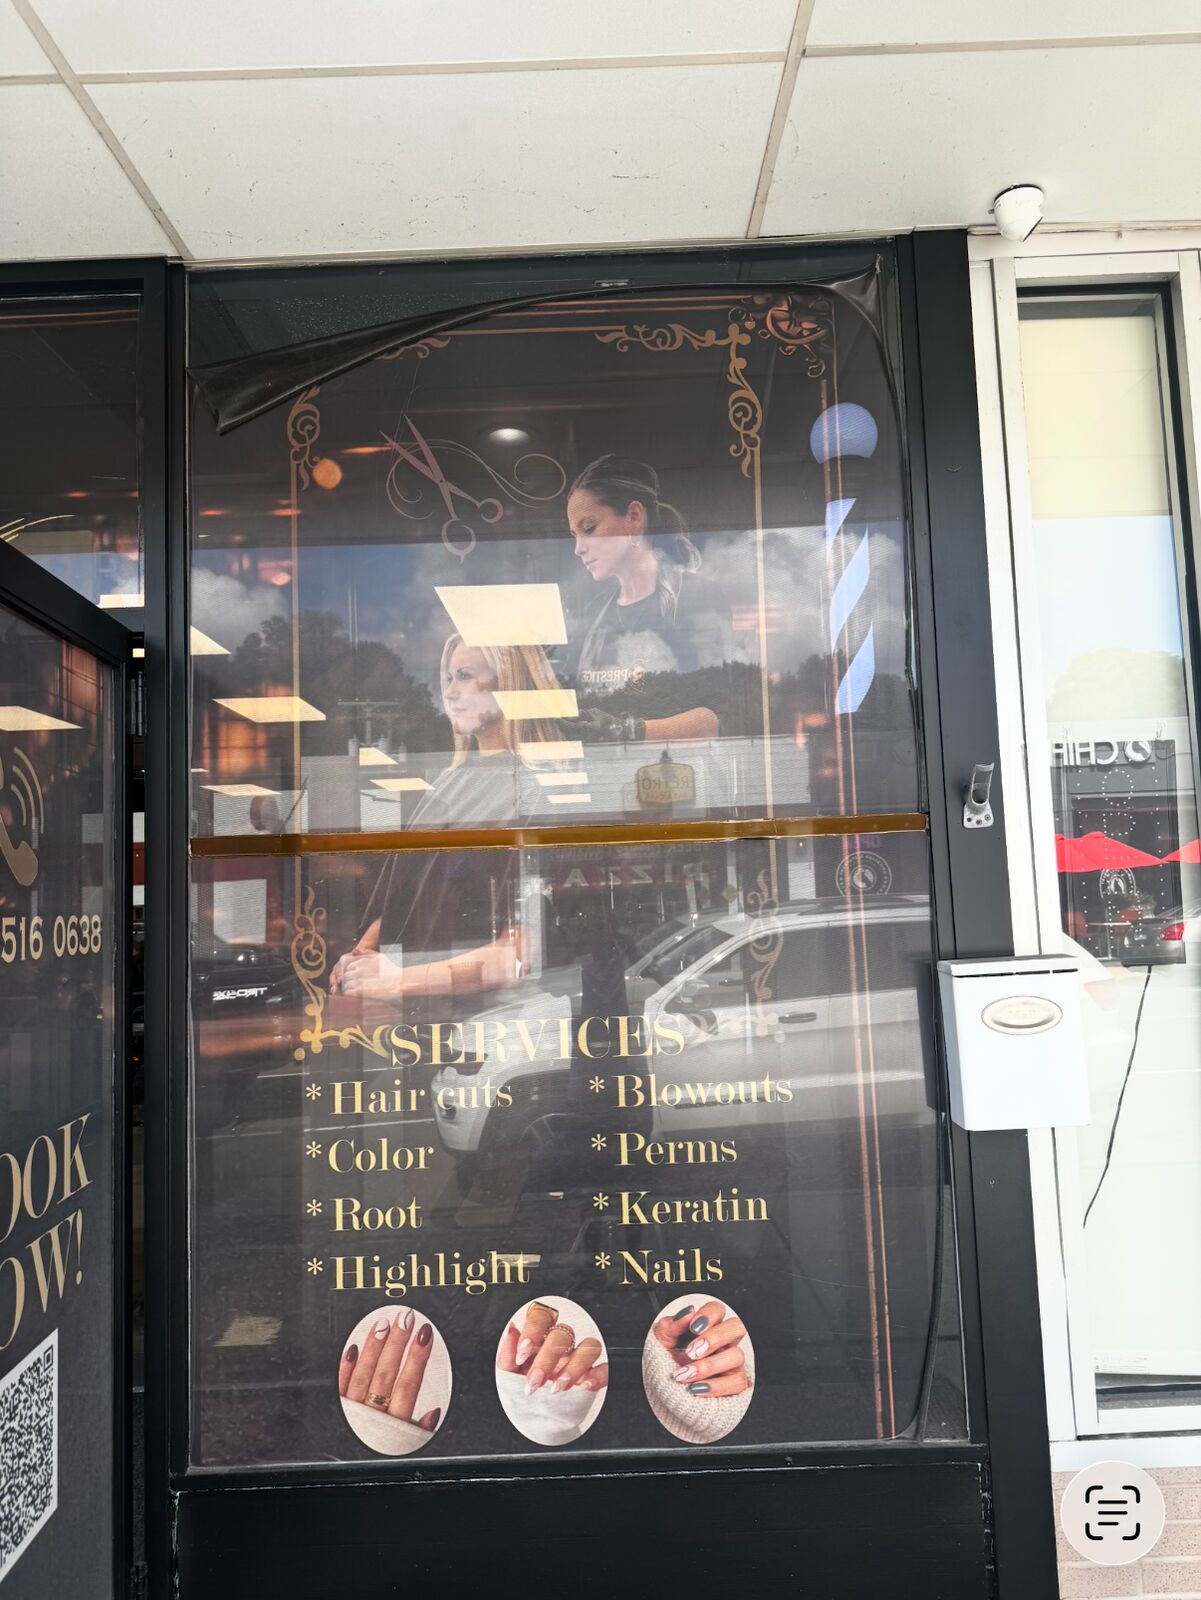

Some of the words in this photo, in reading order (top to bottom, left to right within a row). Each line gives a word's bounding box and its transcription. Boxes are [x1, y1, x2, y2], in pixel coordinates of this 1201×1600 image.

[1, 915, 43, 963] 516
[53, 914, 102, 957] 0638
[389, 1012, 686, 1067] SERVICES
[328, 1079, 426, 1115] Hair
[437, 1074, 513, 1109] cuts
[611, 1071, 794, 1108] Blowouts
[328, 1138, 434, 1174] Color
[613, 1131, 738, 1166] Perms
[329, 1196, 423, 1232] Root
[616, 1187, 771, 1226] Keratin
[329, 1251, 530, 1297] Highlight
[617, 1247, 724, 1285] Nails
